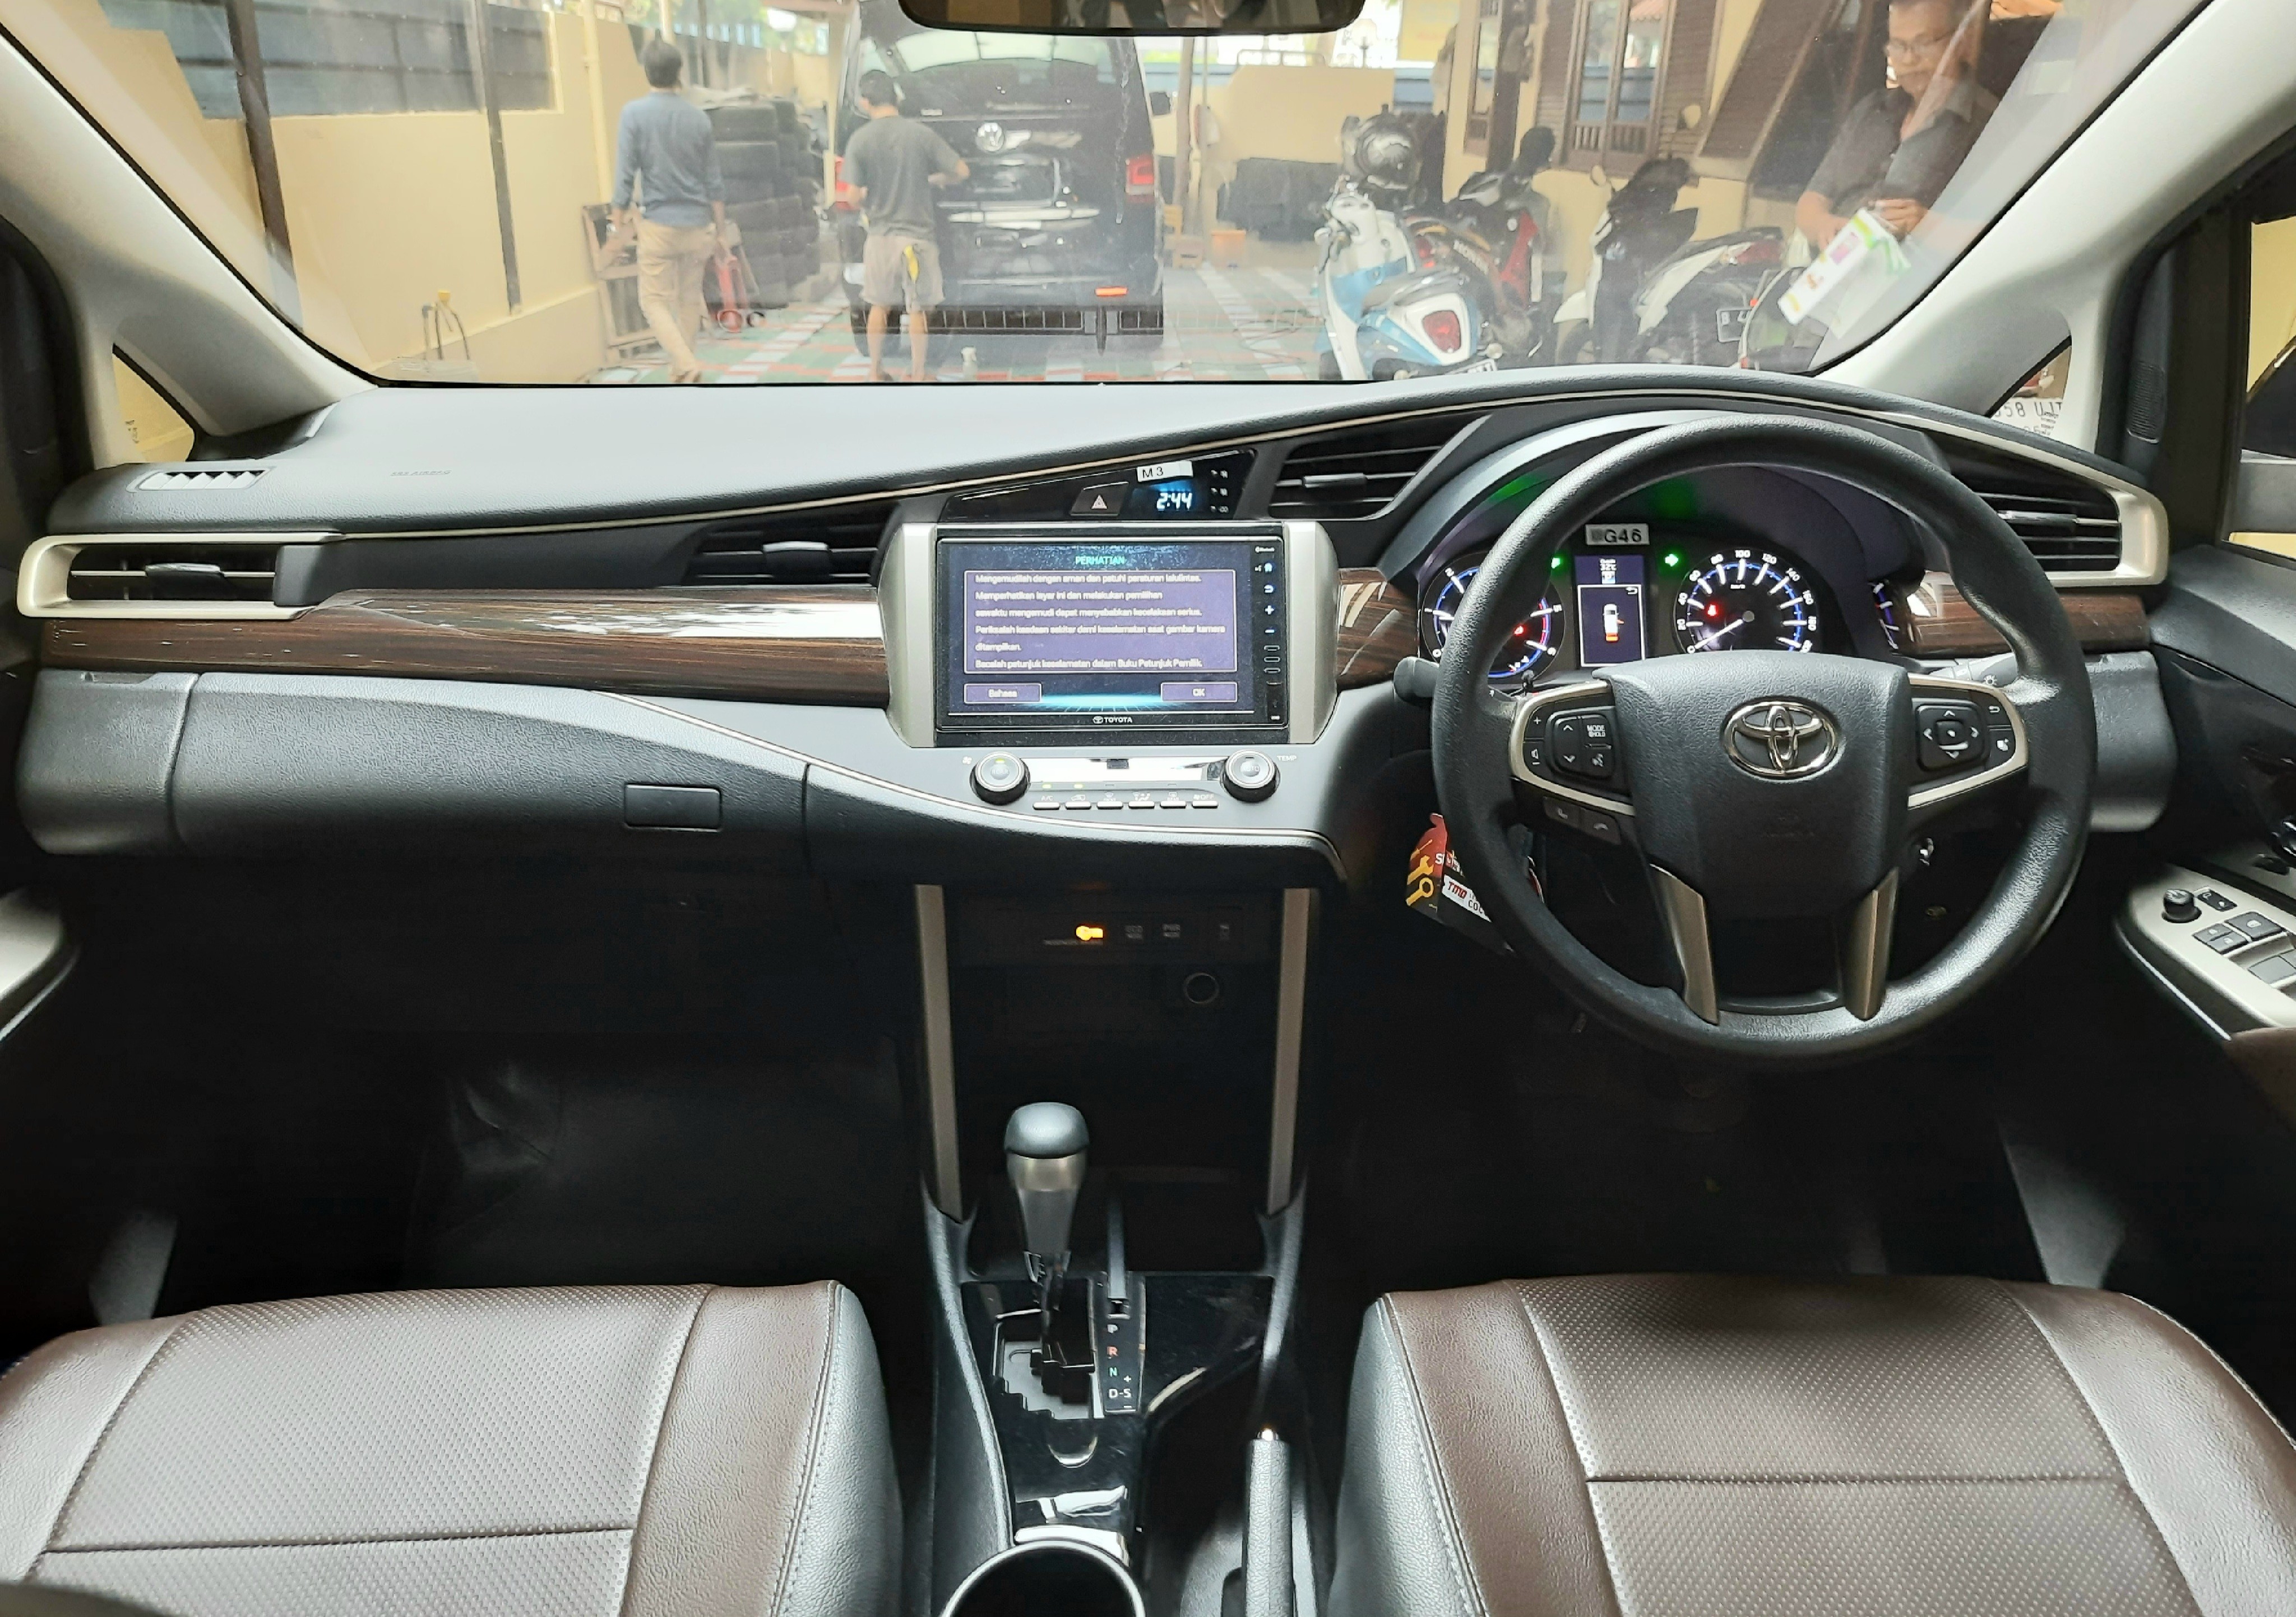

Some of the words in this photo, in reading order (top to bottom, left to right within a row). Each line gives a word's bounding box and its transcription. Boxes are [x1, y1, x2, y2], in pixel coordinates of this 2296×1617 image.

[1156, 493, 1193, 511] 2:44
[1604, 529, 1642, 543] G46
[1075, 555, 1125, 565] PERHATIAN
[1762, 553, 1777, 564] 120
[1033, 574, 1062, 585] dengan
[1086, 574, 1101, 583] dan
[1785, 568, 1800, 582] 140
[1057, 591, 1066, 600] ini
[1067, 591, 1082, 600] dan
[1083, 591, 1124, 600] melakukan
[1125, 591, 1163, 601] pemilihan
[1008, 608, 1054, 618] mengemudi
[1056, 608, 1077, 618] dapat
[1677, 619, 1687, 631] 20
[1432, 648, 1442, 658] 0
[1687, 645, 1696, 654] 0
[1007, 660, 1041, 669] petunjuk
[1092, 659, 1116, 668] dalam
[1118, 659, 1137, 668] Buku
[1138, 659, 1173, 669] Petunjuk
[989, 689, 1017, 698] Bahasa
[1192, 688, 1205, 697] OK
[1107, 1324, 1119, 1333] P
[1107, 1346, 1118, 1356] R
[1109, 1367, 1118, 1377] N
